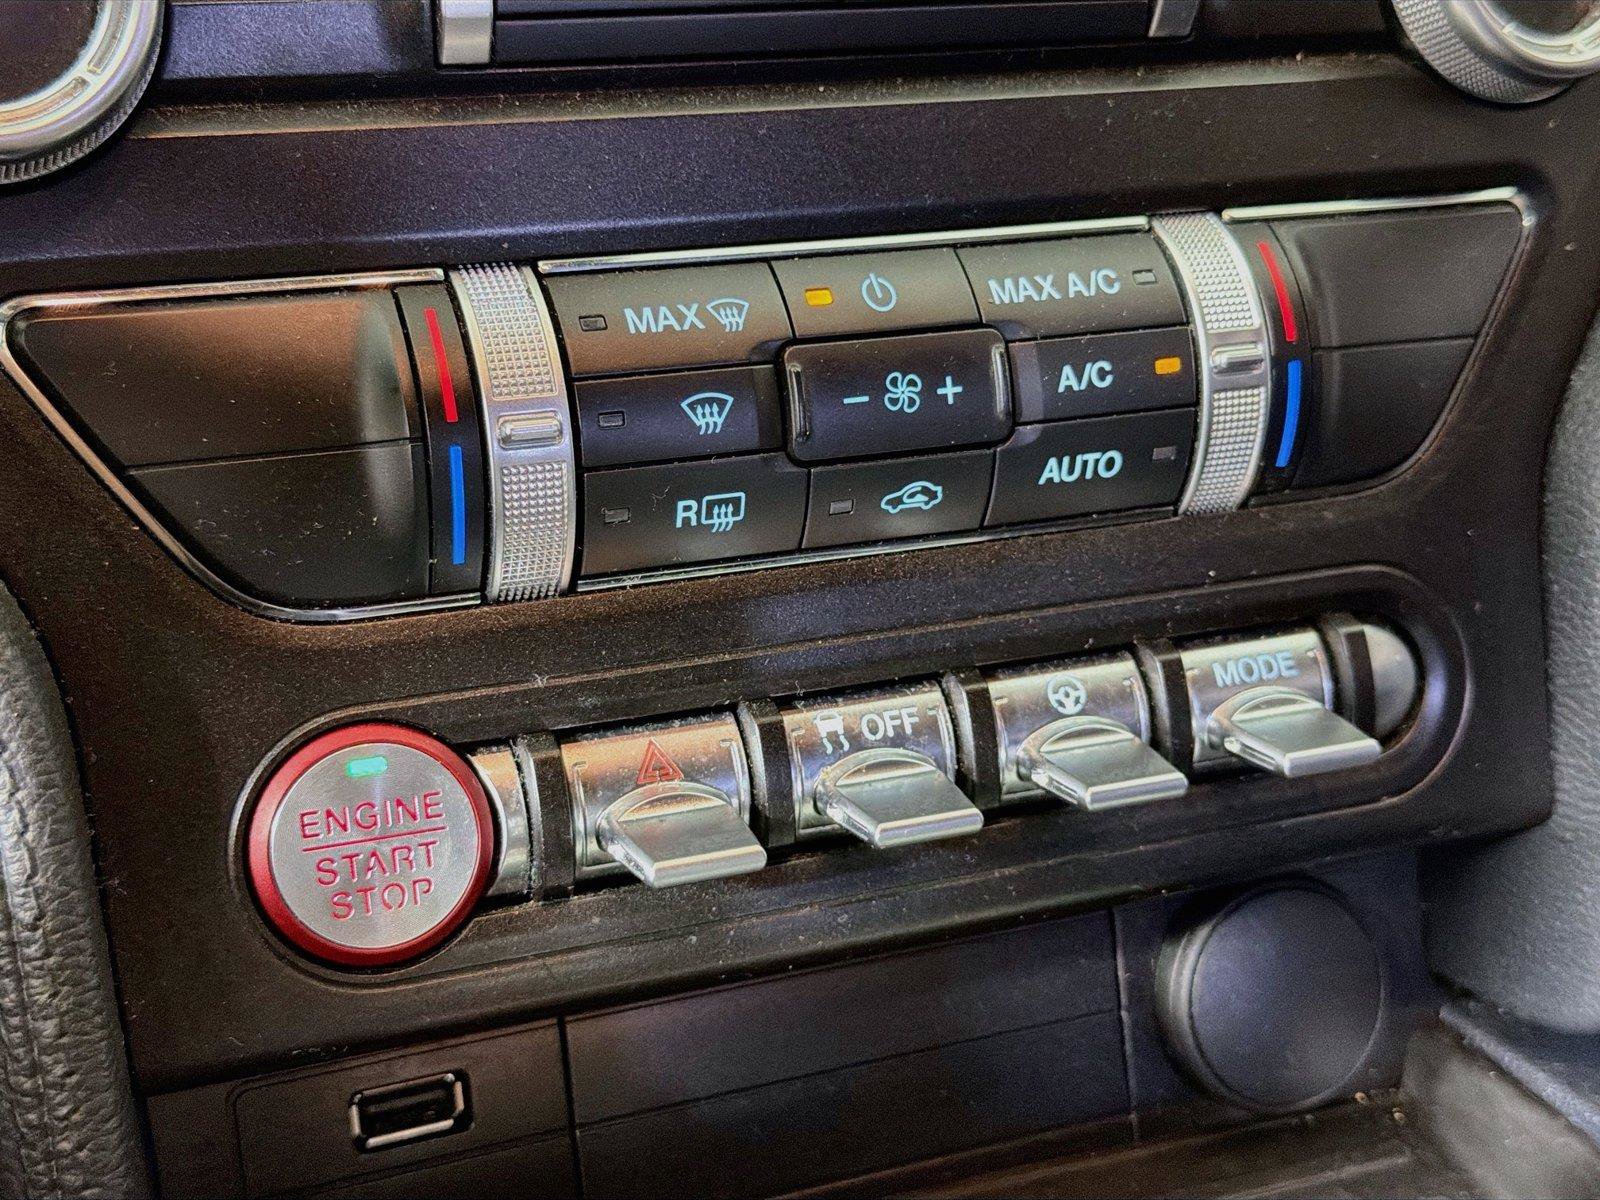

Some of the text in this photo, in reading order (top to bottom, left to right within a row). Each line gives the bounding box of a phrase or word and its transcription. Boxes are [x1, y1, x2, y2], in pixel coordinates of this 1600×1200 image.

[989, 267, 1122, 305] MAX A/C
[624, 303, 706, 335] MAX
[1057, 360, 1114, 393] A/C
[1038, 450, 1124, 485] AUTO
[675, 499, 698, 529] R
[1213, 651, 1299, 687] MODE
[861, 708, 920, 742] OFF
[299, 790, 446, 840] ENGINE
[316, 841, 438, 887] START
[331, 877, 435, 921] STOP
